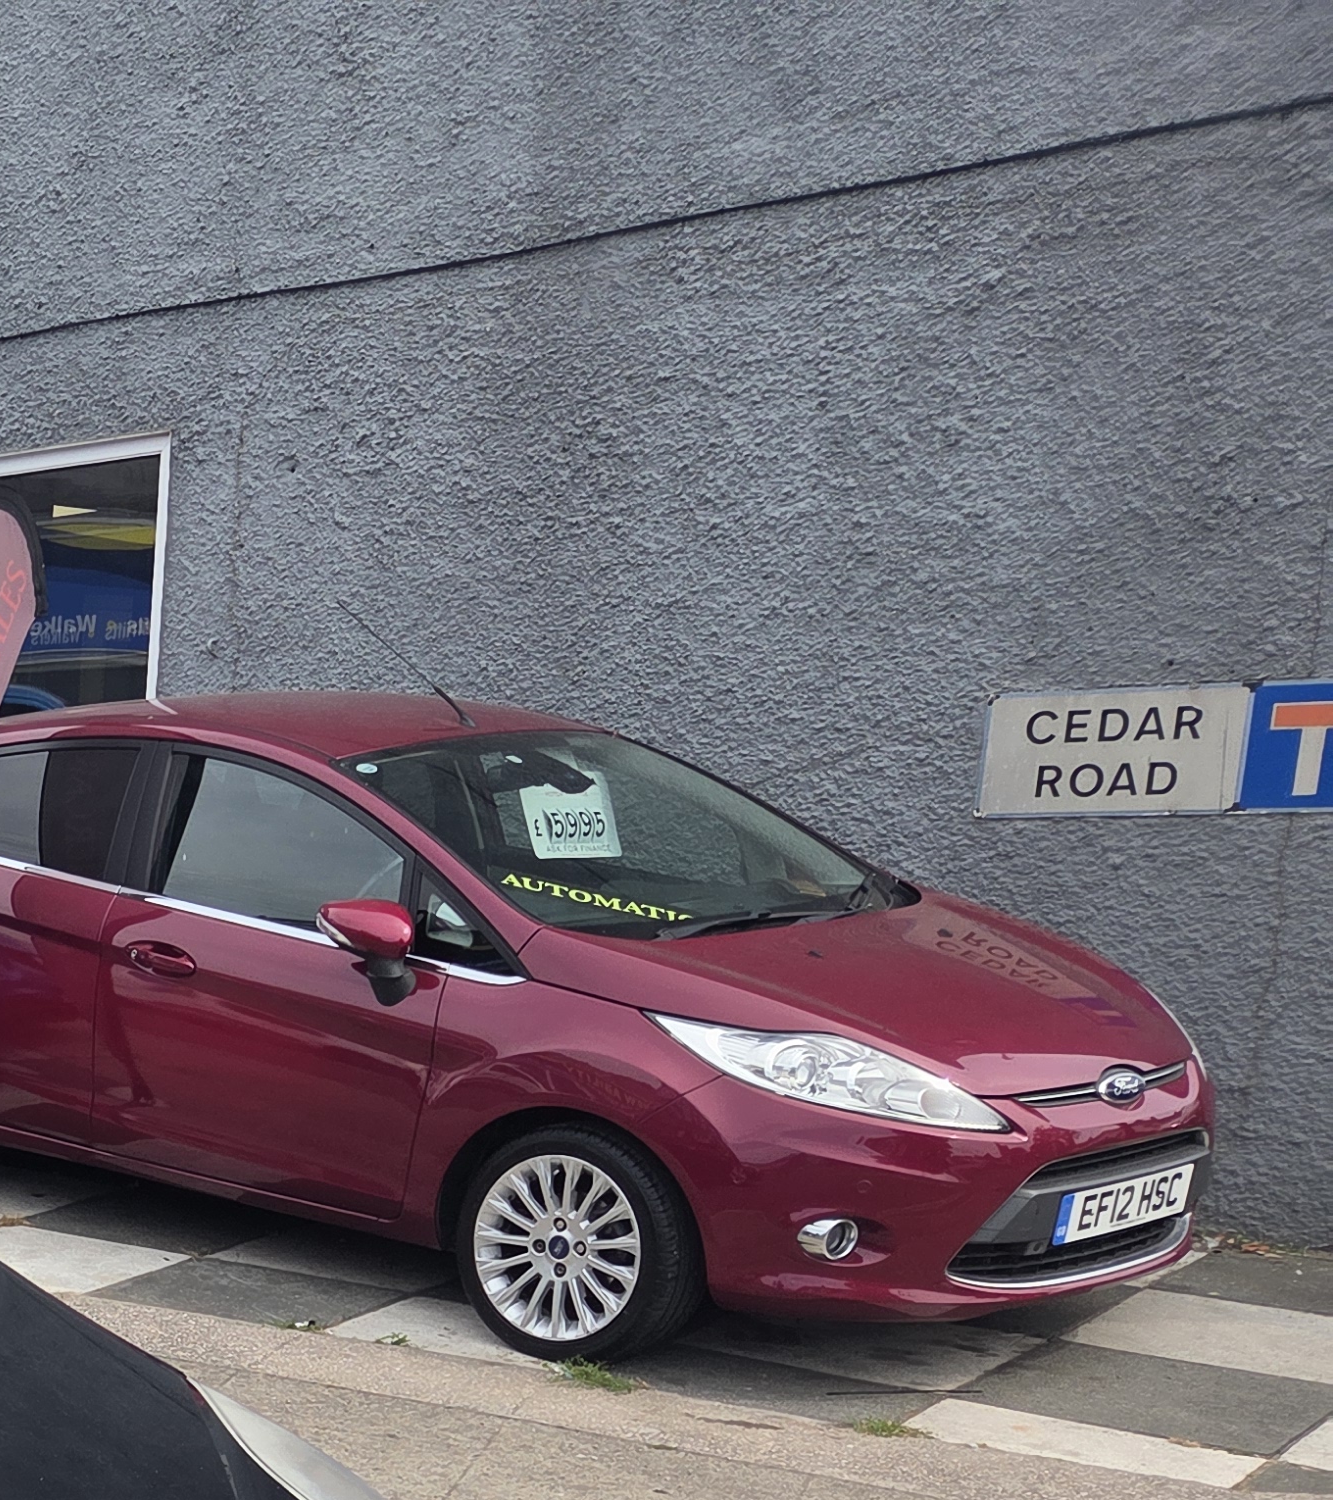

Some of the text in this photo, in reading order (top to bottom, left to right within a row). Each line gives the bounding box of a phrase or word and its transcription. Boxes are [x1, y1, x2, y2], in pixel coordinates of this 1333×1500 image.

[1026, 705, 1203, 744] CEDAR
[1034, 761, 1178, 798] ROAD
[1077, 1172, 1183, 1232] EF12 HSC
